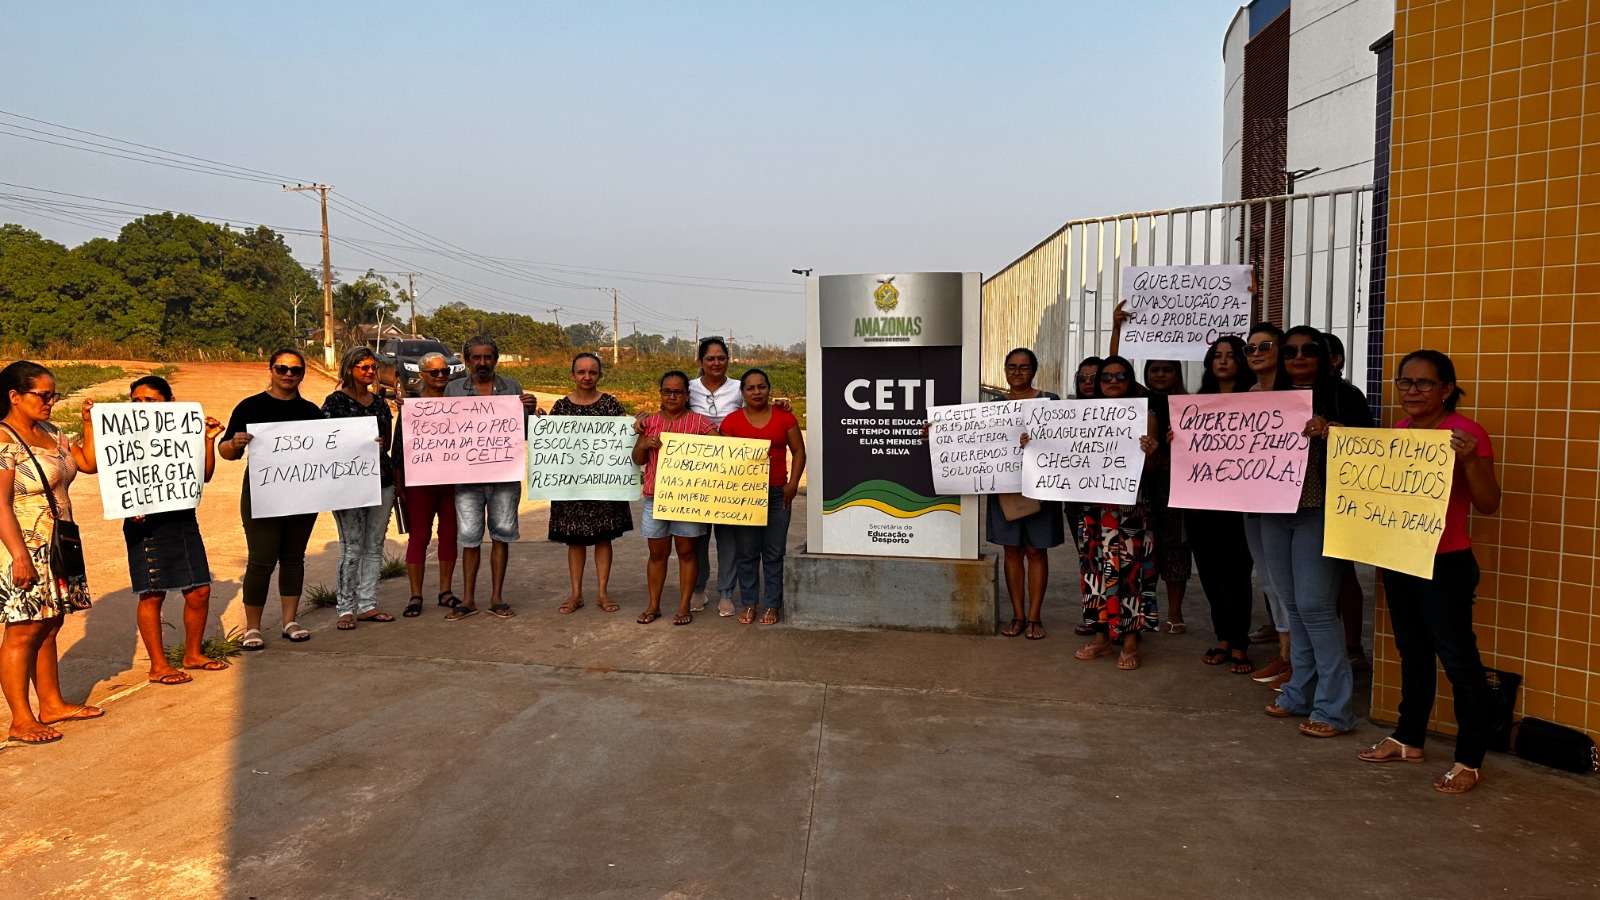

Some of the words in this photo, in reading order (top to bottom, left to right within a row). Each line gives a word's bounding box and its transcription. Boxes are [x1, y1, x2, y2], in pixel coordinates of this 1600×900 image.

[1133, 272, 1232, 290] QUEREMOS
[854, 316, 922, 337] AMAZONAS
[1129, 312, 1147, 324] RA
[1151, 312, 1159, 324] O
[1161, 312, 1229, 327] PROBLEMA
[1233, 314, 1248, 326] DE
[1125, 330, 1184, 343] ENERGIA
[1187, 331, 1202, 343] DO
[844, 379, 935, 410] CETI
[934, 412, 941, 422] O
[945, 408, 976, 420] CETI
[982, 402, 1010, 417] ESTÁ
[1026, 407, 1076, 425] NOSSOS
[1082, 406, 1137, 421] FILHOS
[1180, 404, 1283, 432] QUEREMOS
[102, 409, 149, 435] MAIS
[155, 411, 176, 433] DE
[181, 411, 202, 434] 15
[411, 419, 474, 436] RESOLVA
[477, 422, 487, 433] O
[534, 419, 616, 436] GOVERNADOR,
[936, 422, 947, 433] DE
[951, 422, 962, 431] 15
[964, 420, 986, 431] DIAS
[989, 418, 1013, 427] SEM
[272, 436, 313, 452] ISSO
[326, 429, 340, 449] É
[412, 438, 455, 450] BLEMA
[460, 437, 472, 448] DA
[533, 437, 589, 450] ESCOLAS
[936, 435, 953, 444] GIA
[958, 432, 1008, 443] ELÉTRICA
[1189, 432, 1246, 453] NOSSOS
[1249, 432, 1309, 454] FILHOS
[150, 439, 193, 458] SEM
[412, 453, 432, 464] GIA
[443, 453, 459, 461] DO
[466, 447, 514, 462] CETI
[666, 440, 724, 460] EXISTEM
[940, 447, 1007, 463] QUEREMOS
[1333, 435, 1384, 458] NOSSOS
[1389, 438, 1447, 466] FILHOS
[534, 452, 574, 465] DUAIS
[580, 451, 604, 465] SÃO
[608, 455, 632, 466] SUA
[1037, 453, 1090, 468] CHEGA
[1102, 456, 1126, 468] DE
[116, 462, 196, 488] ENERGIA
[729, 465, 745, 476] NO
[747, 464, 770, 475] CETI
[532, 471, 638, 488] RESPONSABILIDADE
[661, 476, 683, 487] MAS
[686, 479, 691, 487] A
[694, 478, 724, 490] FALTA
[726, 481, 739, 491] DE
[1036, 474, 1071, 489] AULA
[1339, 462, 1445, 499] EXCLUÍDOS
[122, 482, 201, 509] ELÉTRICA
[658, 491, 673, 499] GIA
[678, 492, 710, 502] IMPEDE
[671, 506, 700, 516] VIREM
[1336, 495, 1357, 517] DA
[1363, 502, 1397, 528] SALA
